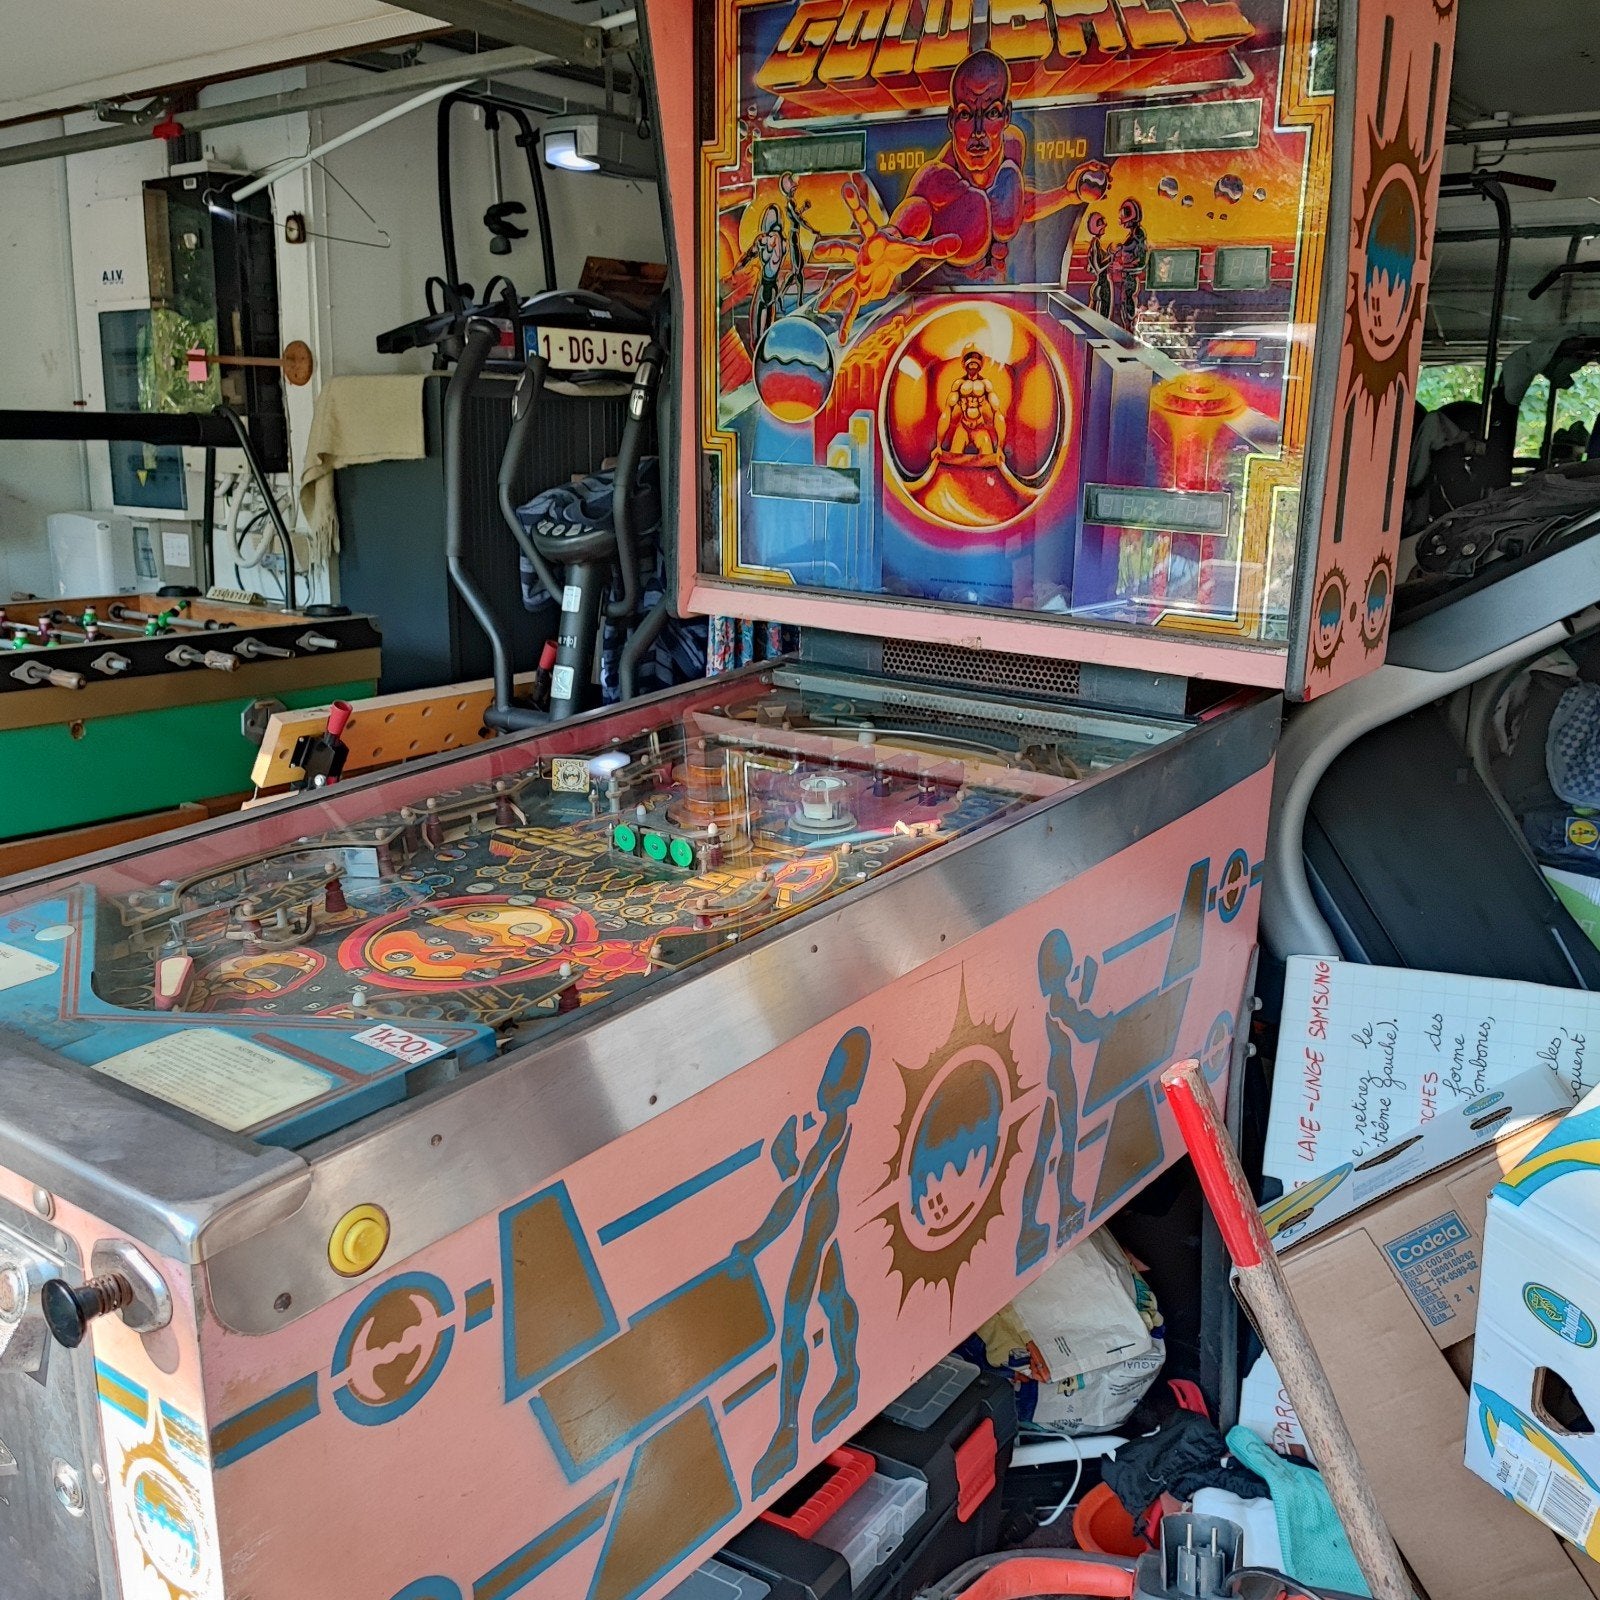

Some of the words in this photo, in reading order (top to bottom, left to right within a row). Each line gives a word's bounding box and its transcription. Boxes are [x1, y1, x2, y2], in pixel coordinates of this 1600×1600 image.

[1308, 961, 1331, 1040] SAMSUNG
[1351, 1021, 1373, 1049] le
[1424, 1013, 1443, 1052] des
[1469, 1016, 1496, 1094] ombones,
[1537, 1027, 1569, 1076] cles,
[1443, 1034, 1477, 1098] forme
[1351, 1069, 1384, 1136] retirez
[1371, 1097, 1392, 1148] trême
[1396, 1224, 1462, 1263] Codela
